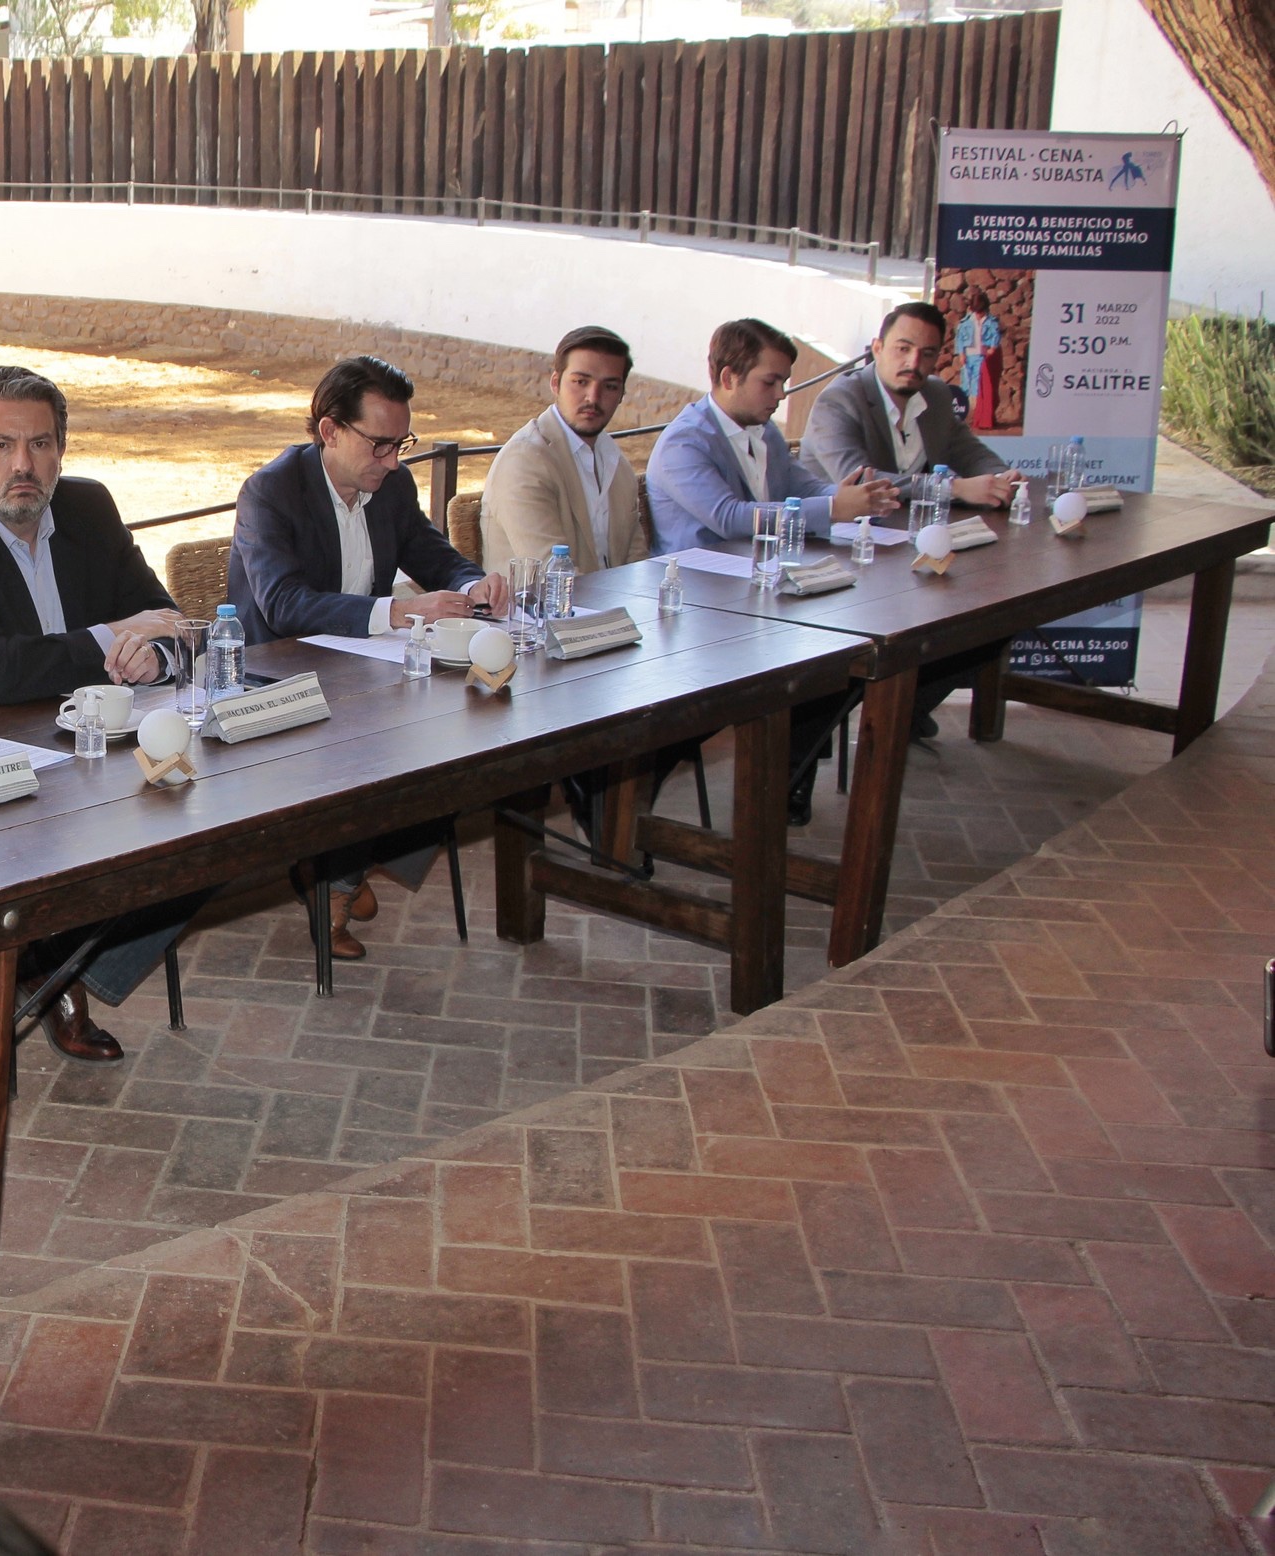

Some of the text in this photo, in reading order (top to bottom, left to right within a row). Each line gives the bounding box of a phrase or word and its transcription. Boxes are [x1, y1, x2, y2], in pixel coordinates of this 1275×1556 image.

[951, 146, 1084, 163] FESTIVAL CENA
[950, 162, 1104, 183] GALERÍA SUBASTA
[973, 215, 1134, 230] EVENTO A BENEFICIO DE
[957, 229, 1148, 245] LAS PERSONAS CON AUTISMO
[1001, 244, 1103, 258] Y SUS FAMILIAS
[1060, 303, 1138, 324] 31 MARZO
[1094, 315, 1121, 326] 2022
[1058, 336, 1132, 355] 5:30 P.M.
[1063, 374, 1151, 391] SALITRE
[1016, 457, 1042, 469] JOSÉ
[1052, 640, 1085, 650] CENA
[1088, 639, 1129, 651] $2,500
[226, 689, 311, 718] HACIENDA EL SALITRE
